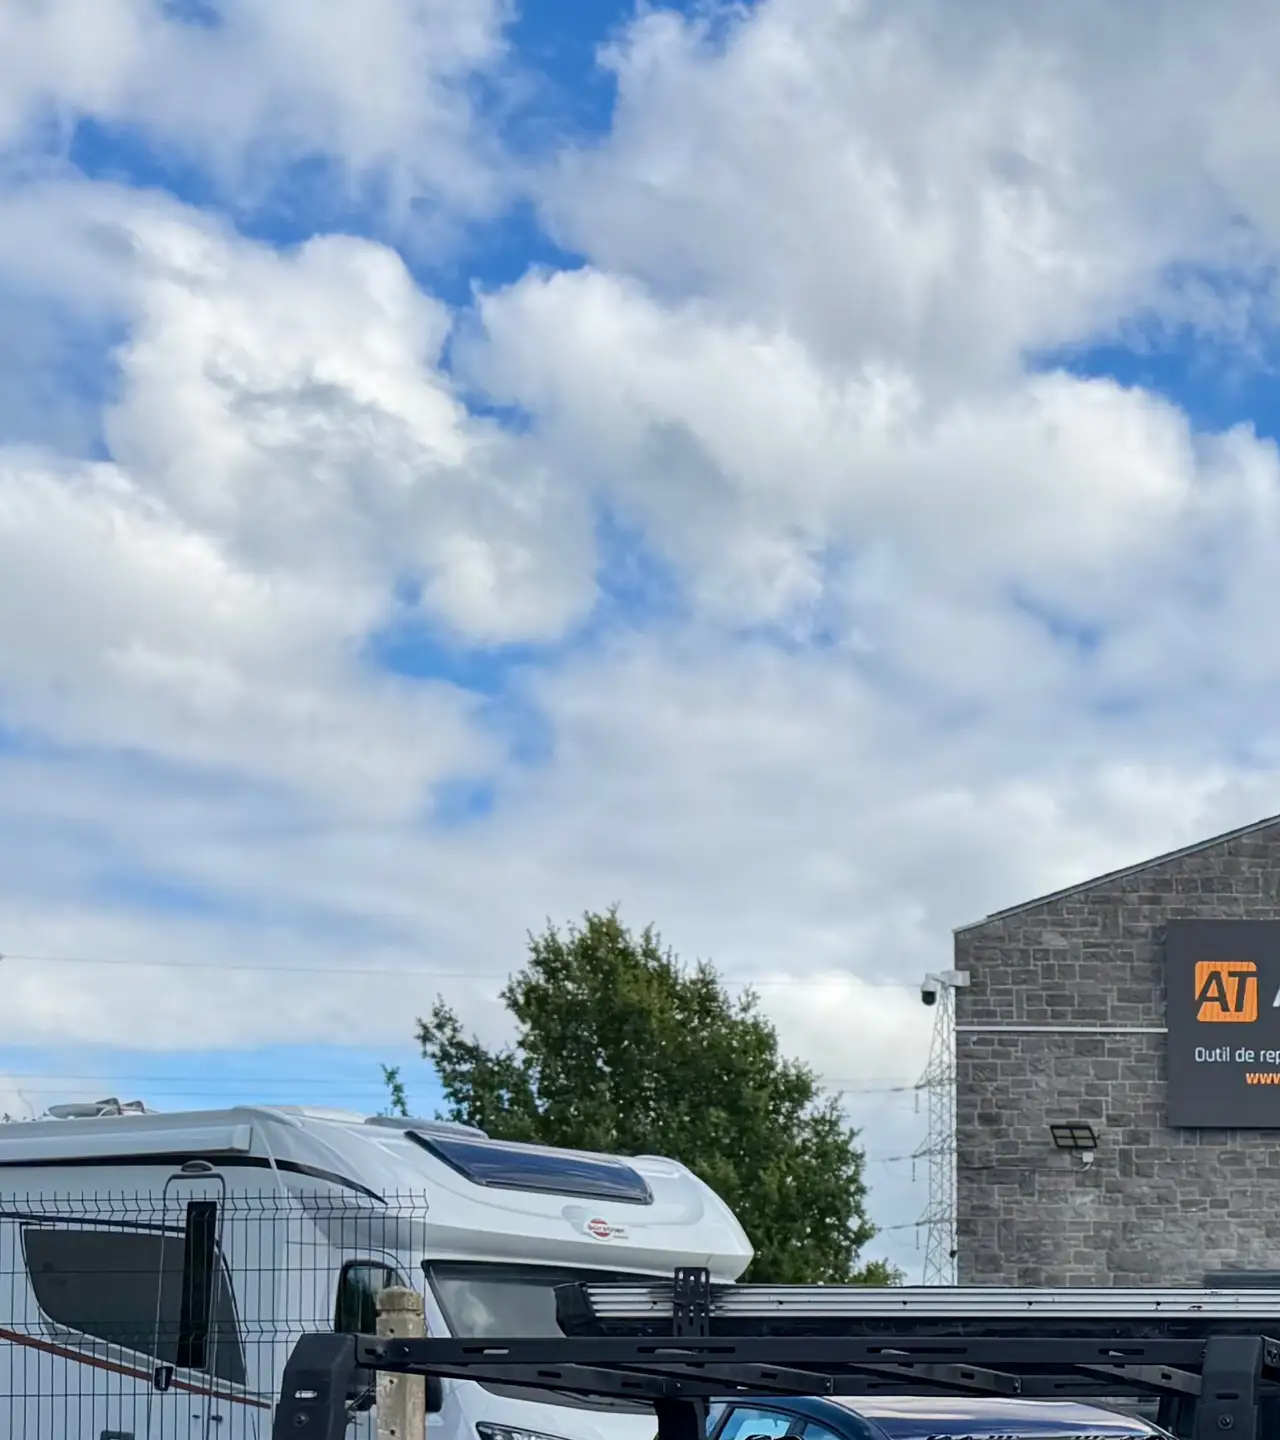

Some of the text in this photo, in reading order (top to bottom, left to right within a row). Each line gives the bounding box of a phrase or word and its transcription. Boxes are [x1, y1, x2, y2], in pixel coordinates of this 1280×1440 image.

[1197, 970, 1257, 1013] AT
[1195, 1046, 1230, 1062] Outil
[1235, 1047, 1254, 1062] de
